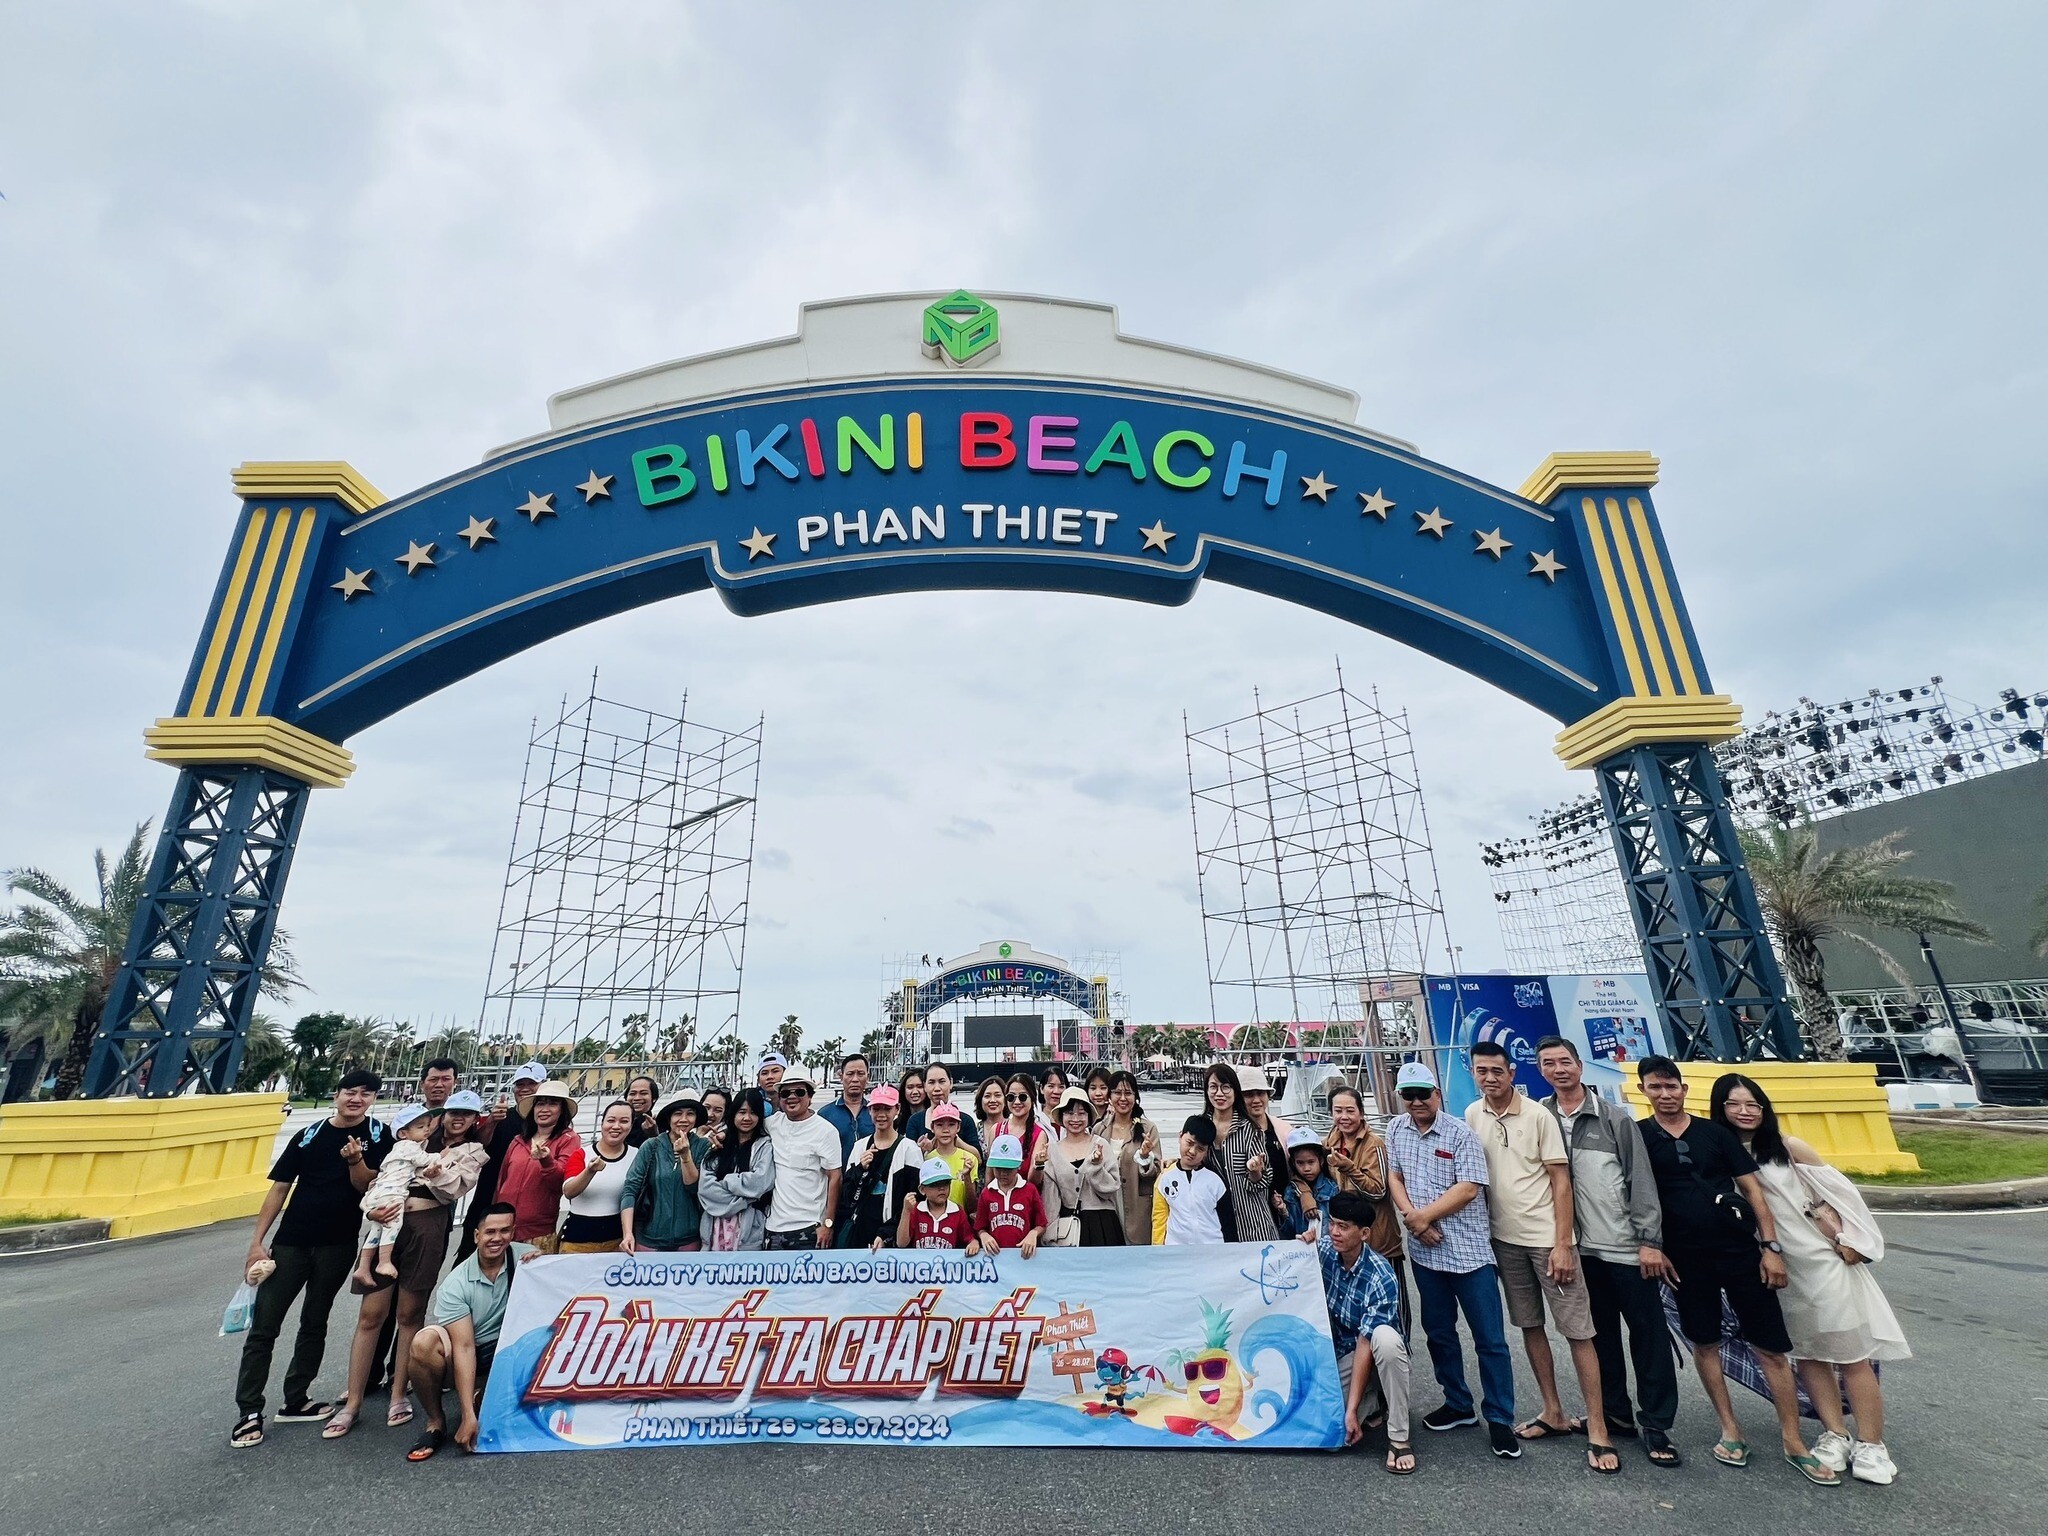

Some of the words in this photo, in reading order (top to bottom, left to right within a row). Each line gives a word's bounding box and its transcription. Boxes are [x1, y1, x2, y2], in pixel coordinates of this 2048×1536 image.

[631, 412, 926, 507] BIKINI
[958, 412, 1289, 506] BEACH
[798, 503, 947, 552] PHAN
[961, 503, 1119, 546] THIET
[956, 968, 1001, 986] BIKINI
[1005, 967, 1055, 984] BEACH
[982, 985, 1004, 994] PHAN
[1007, 985, 1030, 993] THIET
[1461, 983, 1480, 991] VISA
[604, 1258, 668, 1286] CÔNG
[670, 1264, 702, 1285] TY
[704, 1263, 763, 1285] TNHH
[765, 1263, 791, 1284] IN
[791, 1252, 825, 1284] ẤN
[827, 1261, 873, 1284] BAO
[874, 1255, 898, 1283] BÌ
[899, 1255, 962, 1283] NGÂN
[964, 1255, 999, 1283] HÀ
[533, 1297, 682, 1391] ĐOÀN
[670, 1290, 770, 1388] KẾT
[763, 1317, 823, 1388] TA
[824, 1289, 953, 1388] CHẤP
[948, 1287, 1045, 1387] HẾT
[1045, 1323, 1067, 1337] Phan
[624, 1417, 691, 1442] PHAN
[694, 1407, 763, 1439] THIẾT
[766, 1416, 799, 1437] 26
[816, 1415, 952, 1439] 28.07.2024
